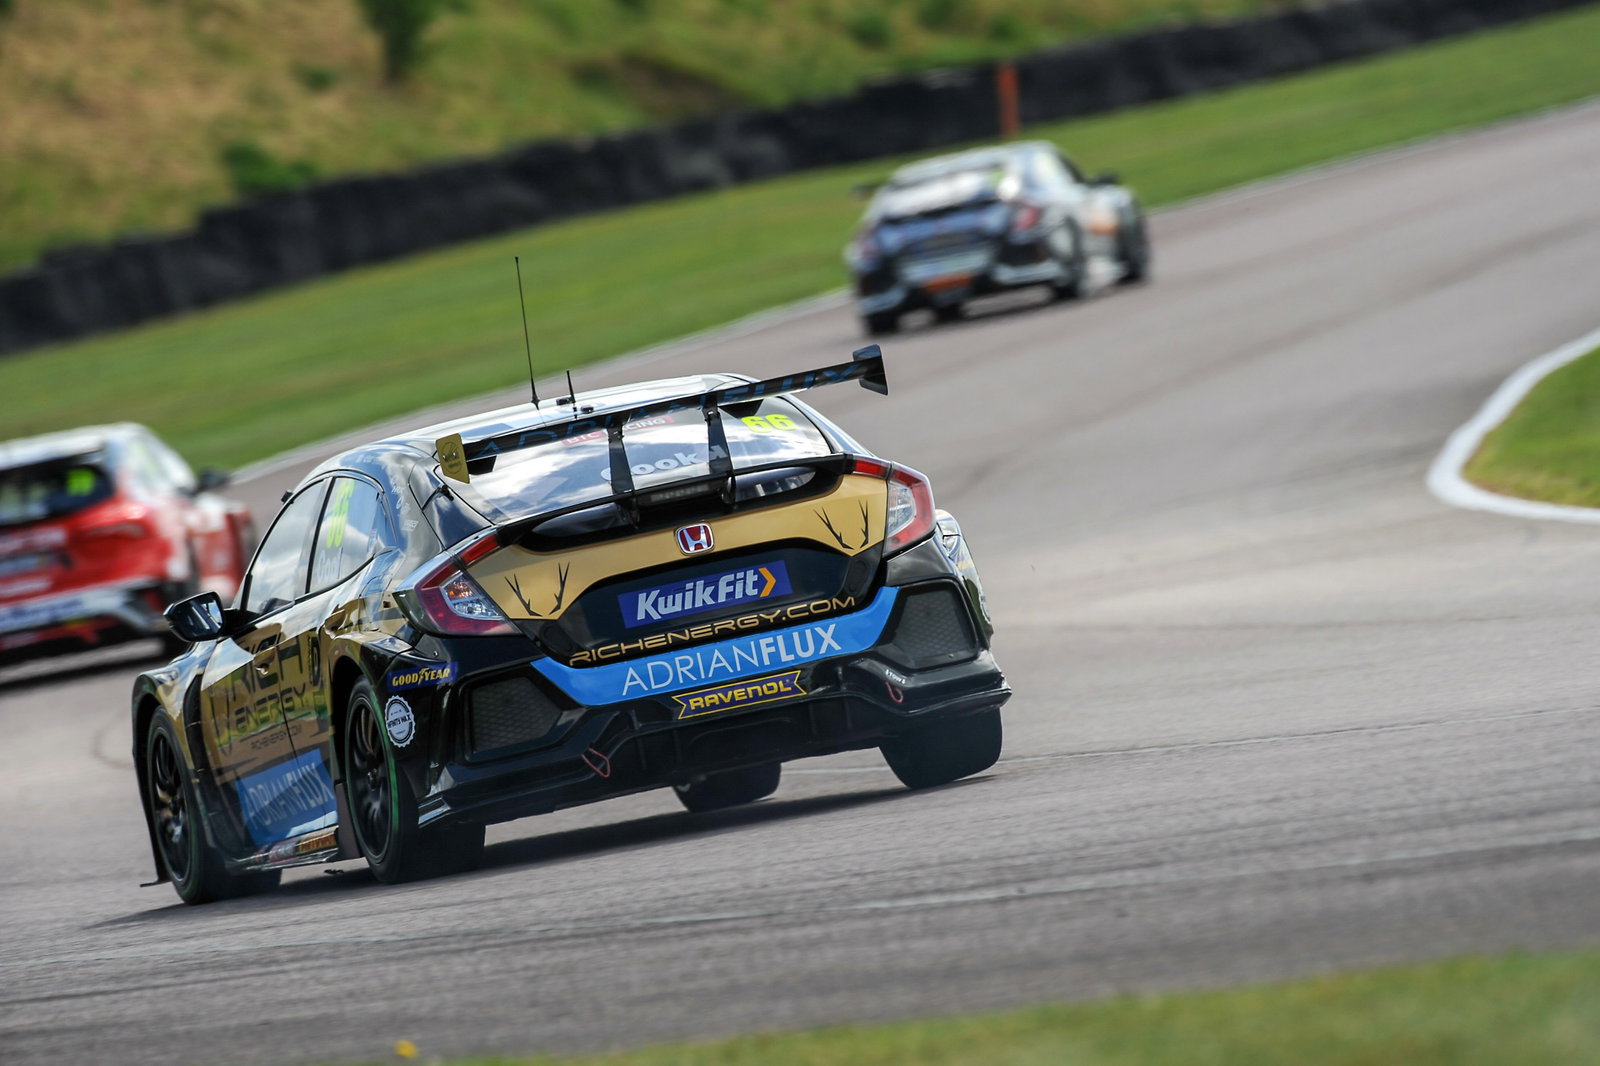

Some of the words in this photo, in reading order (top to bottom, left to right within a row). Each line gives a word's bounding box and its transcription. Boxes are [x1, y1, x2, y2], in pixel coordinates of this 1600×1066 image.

[741, 412, 796, 434] 66
[568, 595, 856, 667] RICHENERGY.COM
[621, 623, 842, 696] ADRIANFLUX
[392, 668, 451, 686] GOODYEAR
[689, 680, 793, 710] RAVENOL
